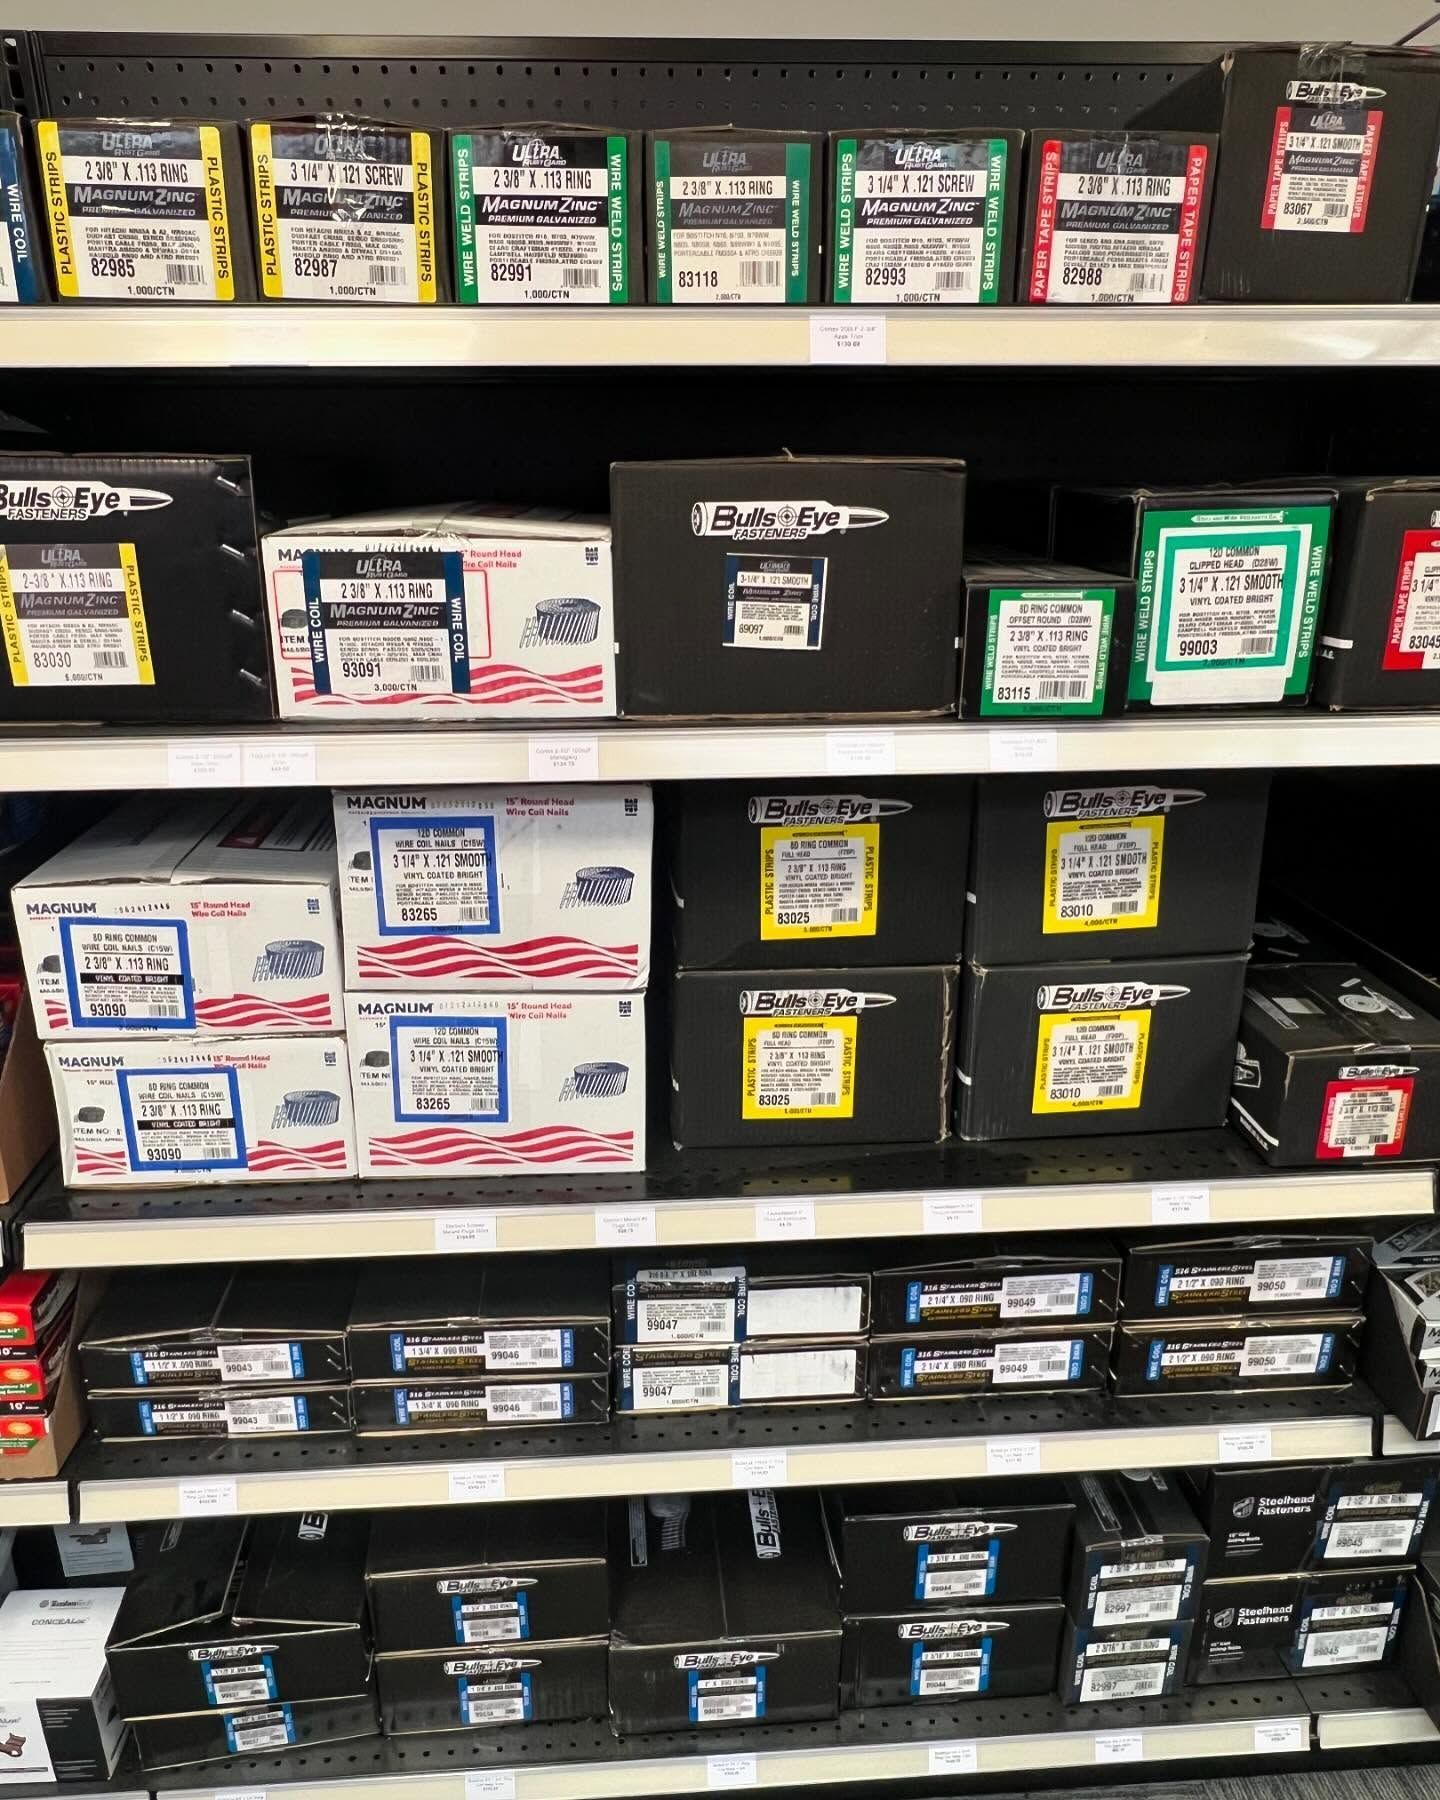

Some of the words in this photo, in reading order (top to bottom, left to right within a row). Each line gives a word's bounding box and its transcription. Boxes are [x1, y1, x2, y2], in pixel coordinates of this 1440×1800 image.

[1296, 83, 1330, 97] Bulls
[1332, 138, 1361, 150] SMOOTH
[46, 151, 62, 206] STRIPS
[86, 163, 91, 181] 2
[98, 162, 118, 181] 3/8"
[124, 164, 130, 181] X
[135, 165, 157, 182] .113
[161, 164, 188, 183] RING
[291, 164, 297, 181] 3
[301, 163, 323, 182] 1/4"
[328, 164, 335, 182] X
[341, 167, 361, 184] 121
[366, 166, 403, 185] SCREW
[458, 149, 469, 199] STRIPS
[494, 170, 500, 188] 2
[504, 171, 525, 188] 3/8"
[530, 171, 536, 188] X
[540, 171, 561, 188] .113
[566, 171, 591, 188] RING
[989, 155, 1001, 191] WIRE
[1042, 151, 1058, 204] STRIPS
[868, 177, 873, 193] 3
[878, 176, 898, 193] 1/4"
[902, 175, 909, 192] X
[913, 175, 933, 192] .121
[938, 175, 974, 192] SCREW
[1079, 176, 1085, 193] 2
[1088, 177, 1109, 195] 3/8"
[1112, 177, 1118, 194] X
[1121, 178, 1142, 195] .113
[1145, 179, 1170, 196] RING
[1283, 203, 1312, 214] 83067
[6, 183, 22, 222] WIRE
[14, 230, 27, 263] COIL
[986, 197, 999, 236] WELD
[460, 205, 472, 246] WELD
[1039, 209, 1051, 246] TAPE
[55, 214, 73, 275] PLASTIC
[91, 258, 135, 278] 82985
[294, 258, 338, 277] 82987
[463, 251, 474, 286] WIRE
[491, 264, 532, 281] 82991
[982, 243, 995, 290] STRIPS
[1034, 251, 1048, 296] PAPER
[679, 271, 718, 287] 83118
[865, 268, 906, 285] 82993
[1062, 268, 1102, 285] 82988
[72, 487, 120, 513] Eye
[8, 509, 86, 519] FASTENERS
[711, 506, 776, 531] Bulls
[796, 507, 840, 530] Eye
[734, 529, 806, 538] FASTENERS
[1225, 547, 1260, 556] COMMON
[1189, 561, 1221, 569] CLIPPED
[1223, 560, 1244, 569] HEAD
[1141, 551, 1155, 593] STRIPS
[89, 573, 112, 588] RING
[1180, 579, 1186, 592] 3
[1189, 576, 1208, 592] 1/4"
[1211, 578, 1218, 591] X
[1220, 576, 1240, 591] .121
[1244, 574, 1283, 591] SMOOTH
[341, 583, 347, 597] 2
[350, 582, 370, 598] 3/8"
[375, 583, 381, 598] X
[384, 583, 405, 598] .113
[409, 582, 432, 599] RING
[1190, 597, 1212, 605] VINYL
[1214, 596, 1244, 604] COATED
[1246, 594, 1273, 603] BRIGHT
[126, 565, 141, 615] PLASTIC
[134, 621, 147, 662] STRIPS
[310, 599, 323, 625] COIL
[1138, 596, 1151, 632] WELD
[1010, 631, 1014, 641] 2
[1018, 630, 1034, 641] 3/8"
[1038, 631, 1043, 640] X
[1046, 631, 1063, 641] .113
[1066, 631, 1088, 641] RING
[312, 628, 325, 663] WIRE
[1134, 634, 1146, 663] WIRE
[1180, 640, 1217, 655] 99003
[34, 652, 71, 668] 83030
[343, 663, 381, 677] 93091
[998, 687, 1030, 699] 83115
[347, 797, 426, 809] MAGNUM
[1060, 792, 1112, 812] Bulls
[1130, 791, 1166, 805] Eye
[765, 799, 818, 819] Bulls
[836, 800, 872, 817] Eye
[1079, 808, 1138, 816] FASTENERS
[784, 816, 845, 824] FASTENERS
[394, 855, 399, 868] 3
[402, 854, 420, 868] 1/4"
[424, 854, 430, 867] X
[433, 854, 450, 867] .121
[455, 853, 491, 868] SMOOTH
[27, 903, 96, 914] MAGNUM
[402, 908, 437, 922] 83265
[1061, 905, 1093, 918] 83010
[778, 912, 809, 924] 83025
[86, 957, 91, 969] 2
[94, 956, 112, 969] 3/8"
[116, 958, 122, 969] X
[125, 958, 143, 970] .113
[147, 957, 169, 970] RING
[755, 993, 807, 1010] Bulls
[823, 993, 857, 1009] Eye
[1052, 988, 1103, 1005] Bulls
[1119, 986, 1153, 1000] Eye
[90, 1004, 126, 1016] 93090
[359, 1003, 433, 1014] MAGNUM
[59, 1056, 123, 1067] MAGNUM
[759, 1095, 790, 1105] 83025
[1050, 1088, 1081, 1099] 83010
[416, 1098, 450, 1110] 83265
[147, 1148, 181, 1160] 93090
[1257, 1281, 1285, 1291] 99050
[1008, 1298, 1036, 1307] 99049
[647, 1320, 678, 1330] 99047
[491, 1351, 519, 1359] 99046
[1247, 1357, 1276, 1366] 99050
[226, 1364, 252, 1372] 99043
[1000, 1364, 1027, 1373] 99049
[643, 1387, 672, 1397] 99047
[493, 1404, 519, 1412] 99046
[1259, 1495, 1315, 1506] Steelhead
[1257, 1505, 1312, 1516] Fasteners
[914, 1526, 953, 1539] Bulls
[447, 1581, 480, 1591] Bulls
[491, 1579, 513, 1588] Eye
[1239, 1605, 1293, 1616] Steelhead
[1238, 1615, 1289, 1625] Fasteners
